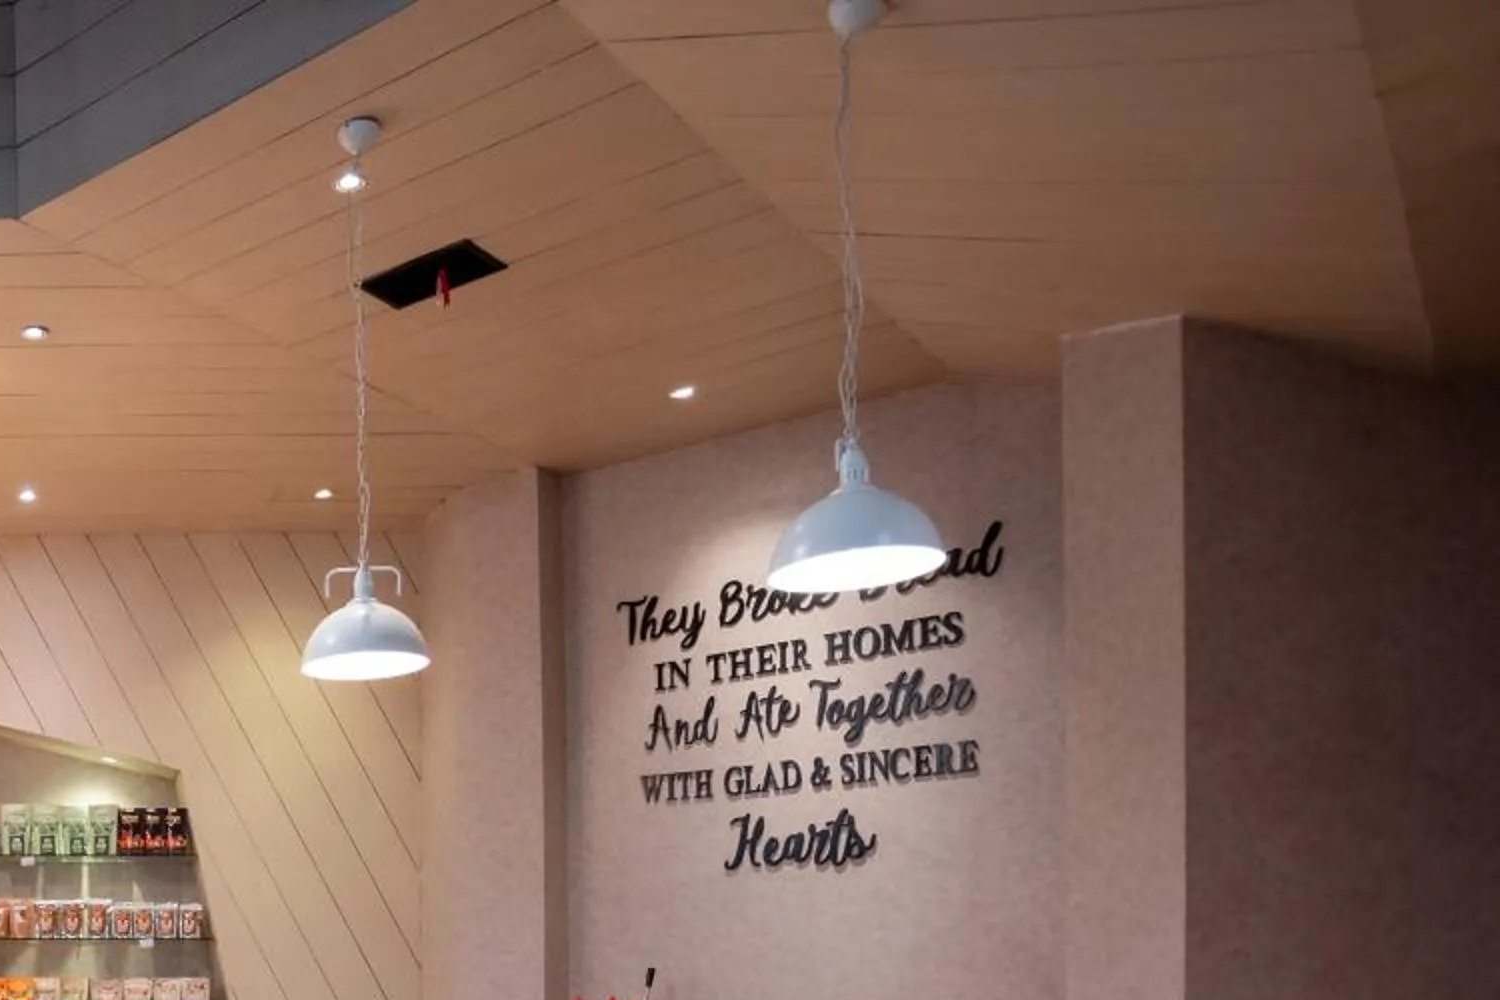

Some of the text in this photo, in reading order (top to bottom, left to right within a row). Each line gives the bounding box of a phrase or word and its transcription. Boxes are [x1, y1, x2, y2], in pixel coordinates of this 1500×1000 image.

[616, 595, 706, 651] They
[653, 611, 965, 693] IN THEIR HOMES
[644, 668, 978, 753] And Ate Together
[640, 740, 981, 805] WITH GLAD & SINCERE
[723, 807, 877, 874] Hearts
